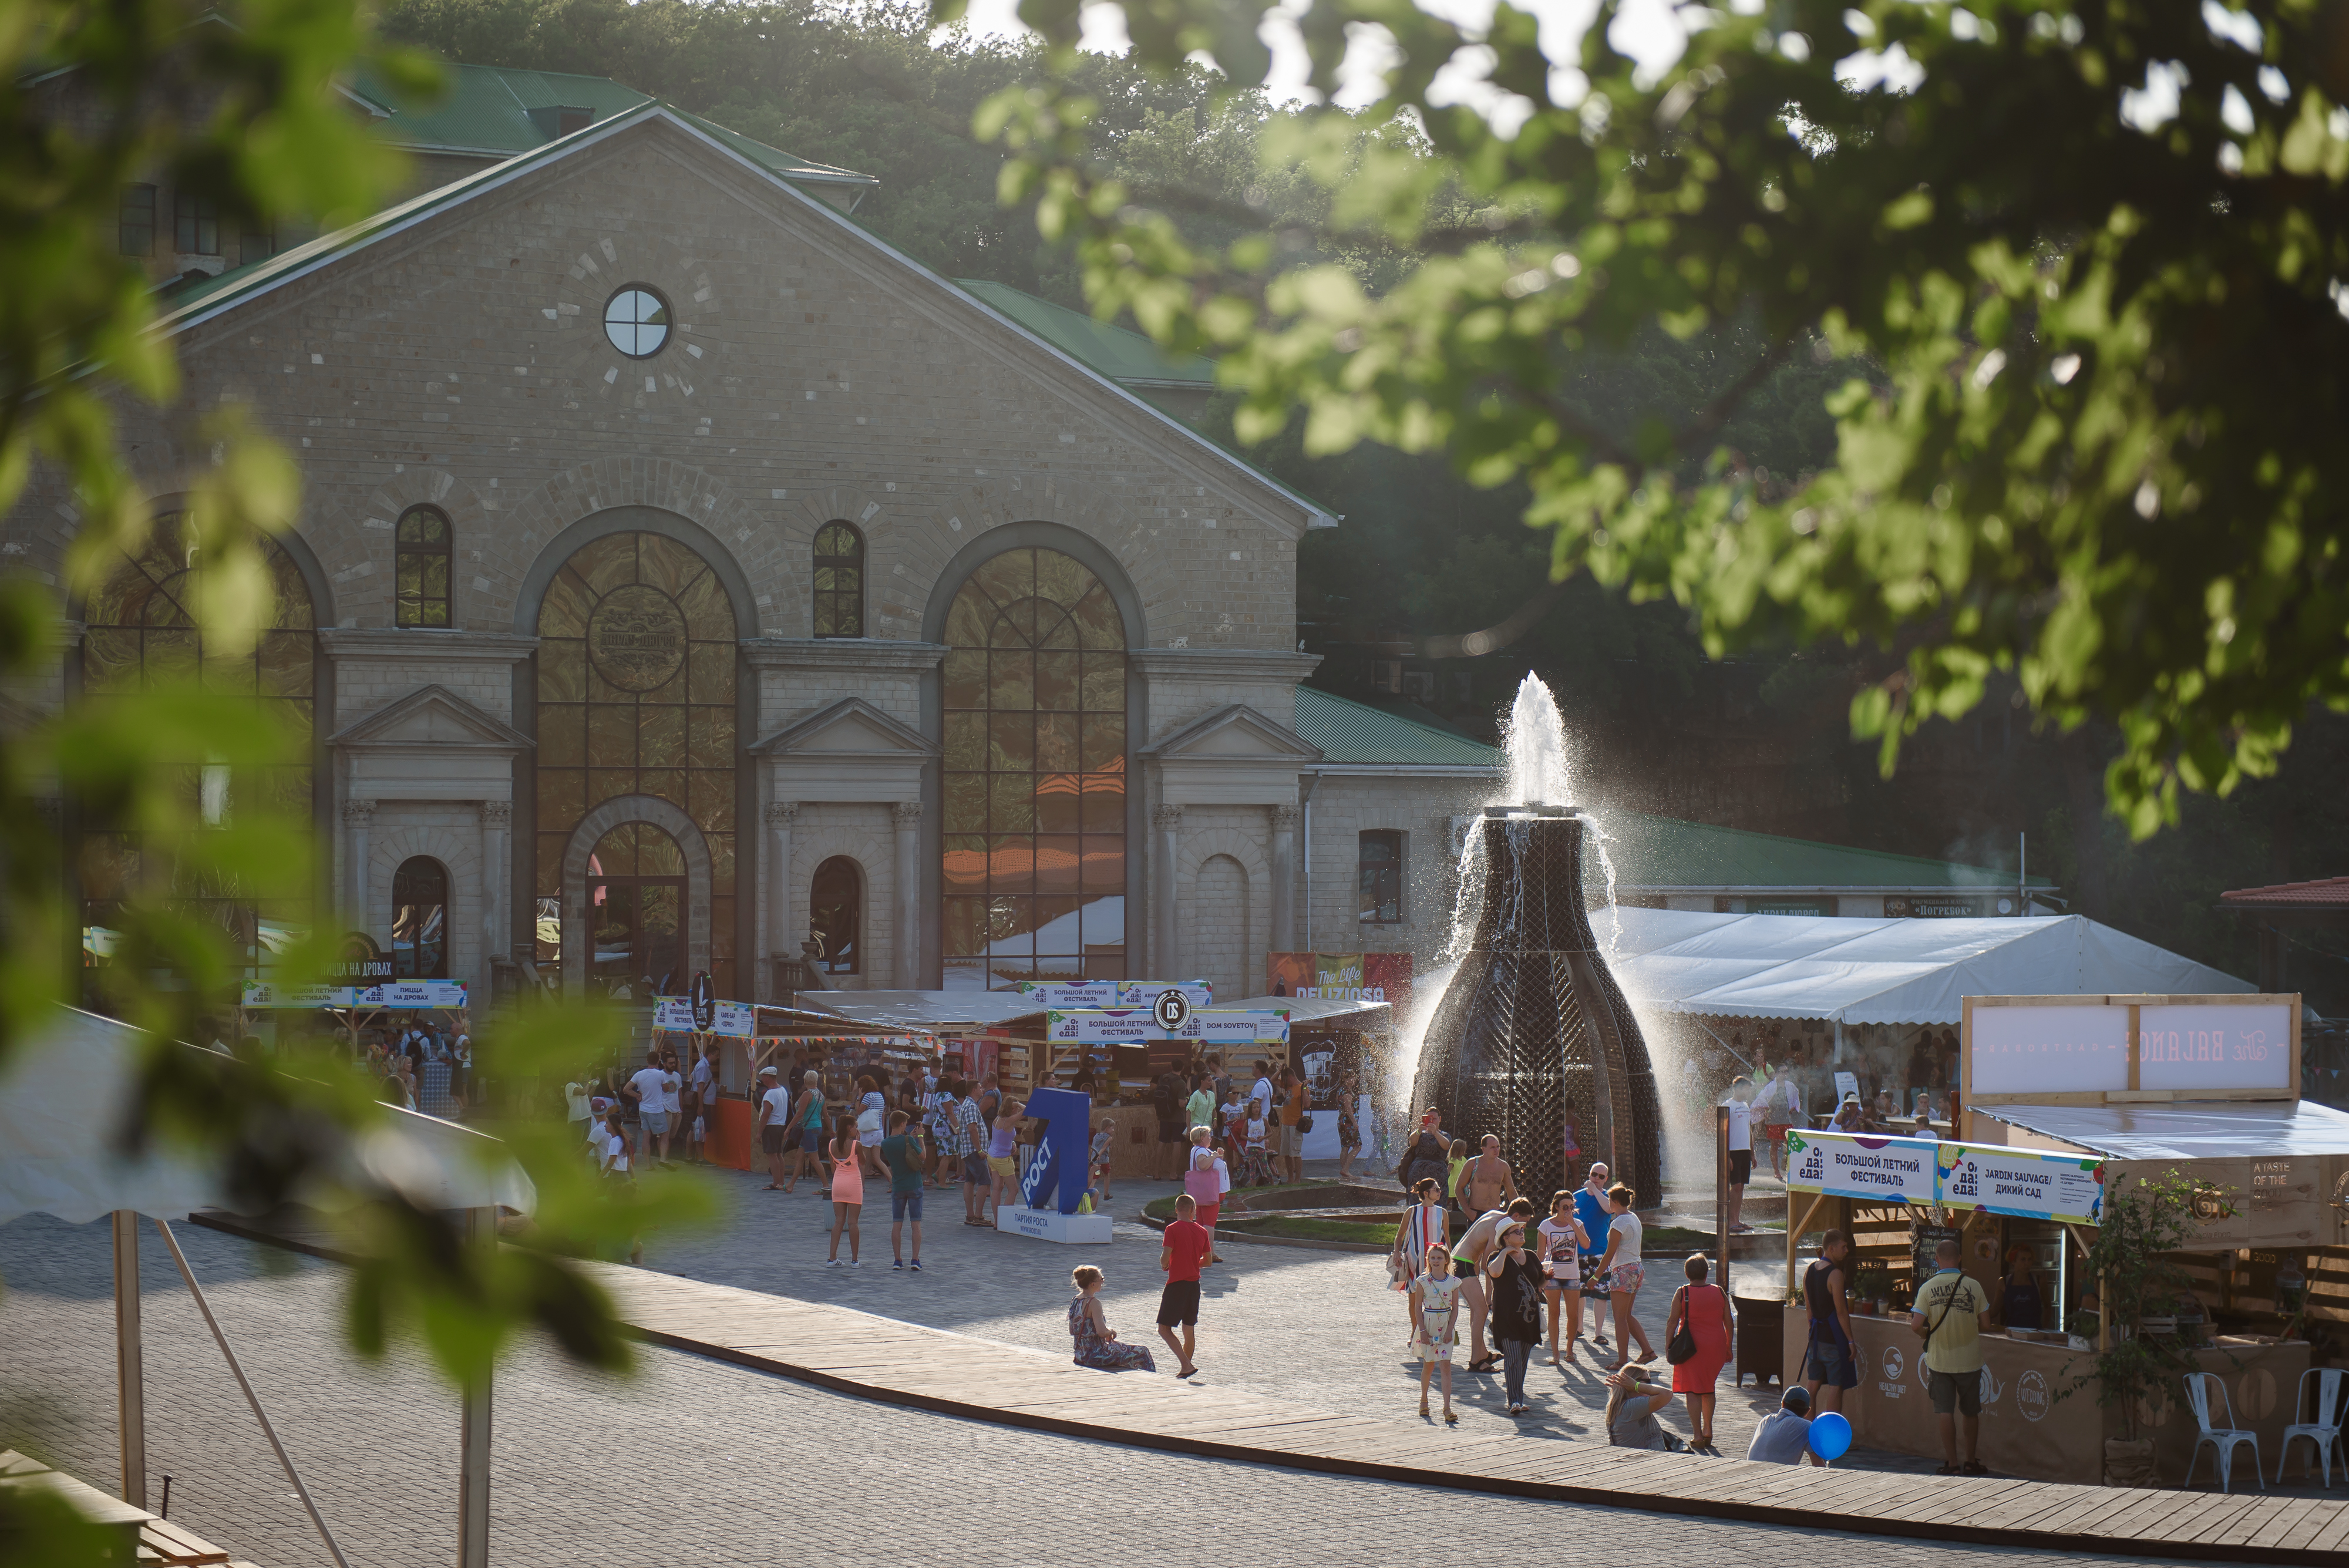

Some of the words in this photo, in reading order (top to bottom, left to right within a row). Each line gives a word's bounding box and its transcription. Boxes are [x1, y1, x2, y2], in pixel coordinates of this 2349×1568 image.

[1915, 905, 1971, 916] «ПОГРЕБОК»
[321, 963, 346, 977] ПИЦЦА
[349, 963, 359, 975] НА
[362, 963, 391, 977] ДРОВАХ
[1318, 971, 1336, 986] The
[1338, 966, 1361, 986] Life
[1166, 1002, 1179, 1019] DS
[1089, 1019, 1125, 1028] БОЛЬШОЙ
[1126, 1019, 1156, 1027] ЛЕТНИЙ
[1813, 1147, 1823, 1157] о,
[1806, 1158, 1823, 1169] да!
[1835, 1153, 1880, 1167] БОЛЬШОЙ
[1883, 1159, 1920, 1172] ЛЕТНИЙ
[1967, 1162, 1978, 1172] о,
[2254, 1163, 2260, 1173] A
[2263, 1162, 2290, 1172] TASTE
[1022, 1136, 1051, 1202] РОСТ
[1799, 1167, 1823, 1180] еда!
[1851, 1170, 1904, 1186] ФЕСТИВАЛЬ
[1959, 1173, 1978, 1185] да!
[1985, 1169, 2013, 1180] JARDIN
[2014, 1172, 2052, 1186] SAUVAGE/
[2254, 1175, 2266, 1186] OF
[2268, 1175, 2287, 1185] THE
[1953, 1184, 1978, 1196] еда!
[1995, 1184, 2024, 1196] ДИКИЙ
[2025, 1187, 2042, 1199] САД
[2254, 1189, 2281, 1199] GOOD
[2254, 1202, 2272, 1211] LIFE
[1014, 1213, 1032, 1224] ПАРТИЯ
[1033, 1216, 1048, 1227] РОСТА
[1020, 1226, 1042, 1235] WWW.ROST.RU
[1879, 1381, 1897, 1392] HEALTHY
[1897, 1385, 1906, 1394] DIET
[2021, 1388, 2045, 1406] WEDDING
